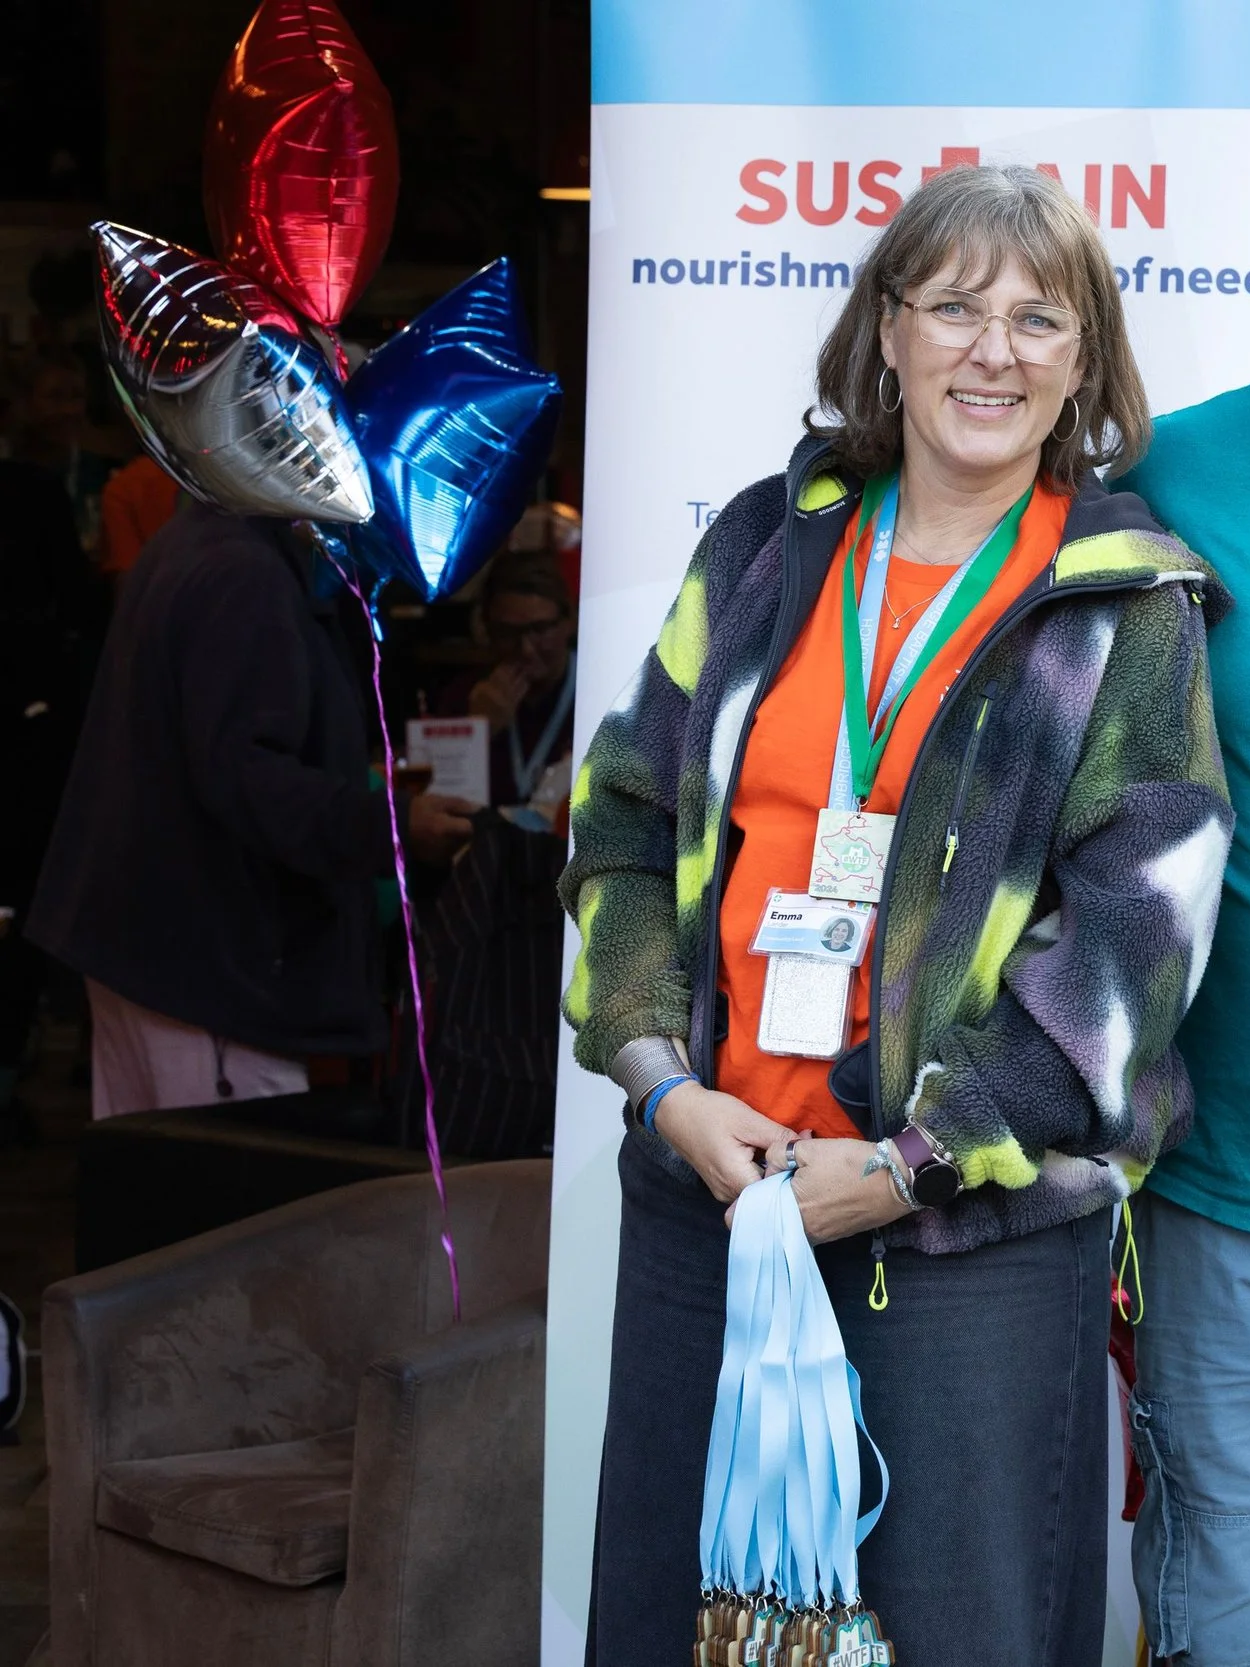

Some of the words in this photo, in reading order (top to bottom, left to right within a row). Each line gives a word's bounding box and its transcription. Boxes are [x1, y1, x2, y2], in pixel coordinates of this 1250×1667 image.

[735, 147, 1167, 229] SUSIN
[632, 250, 851, 289] nourishm
[687, 501, 721, 529] Te
[891, 629, 929, 687] BAPTIST
[832, 739, 852, 812] ONBRIDGE
[770, 911, 804, 921] Emma
